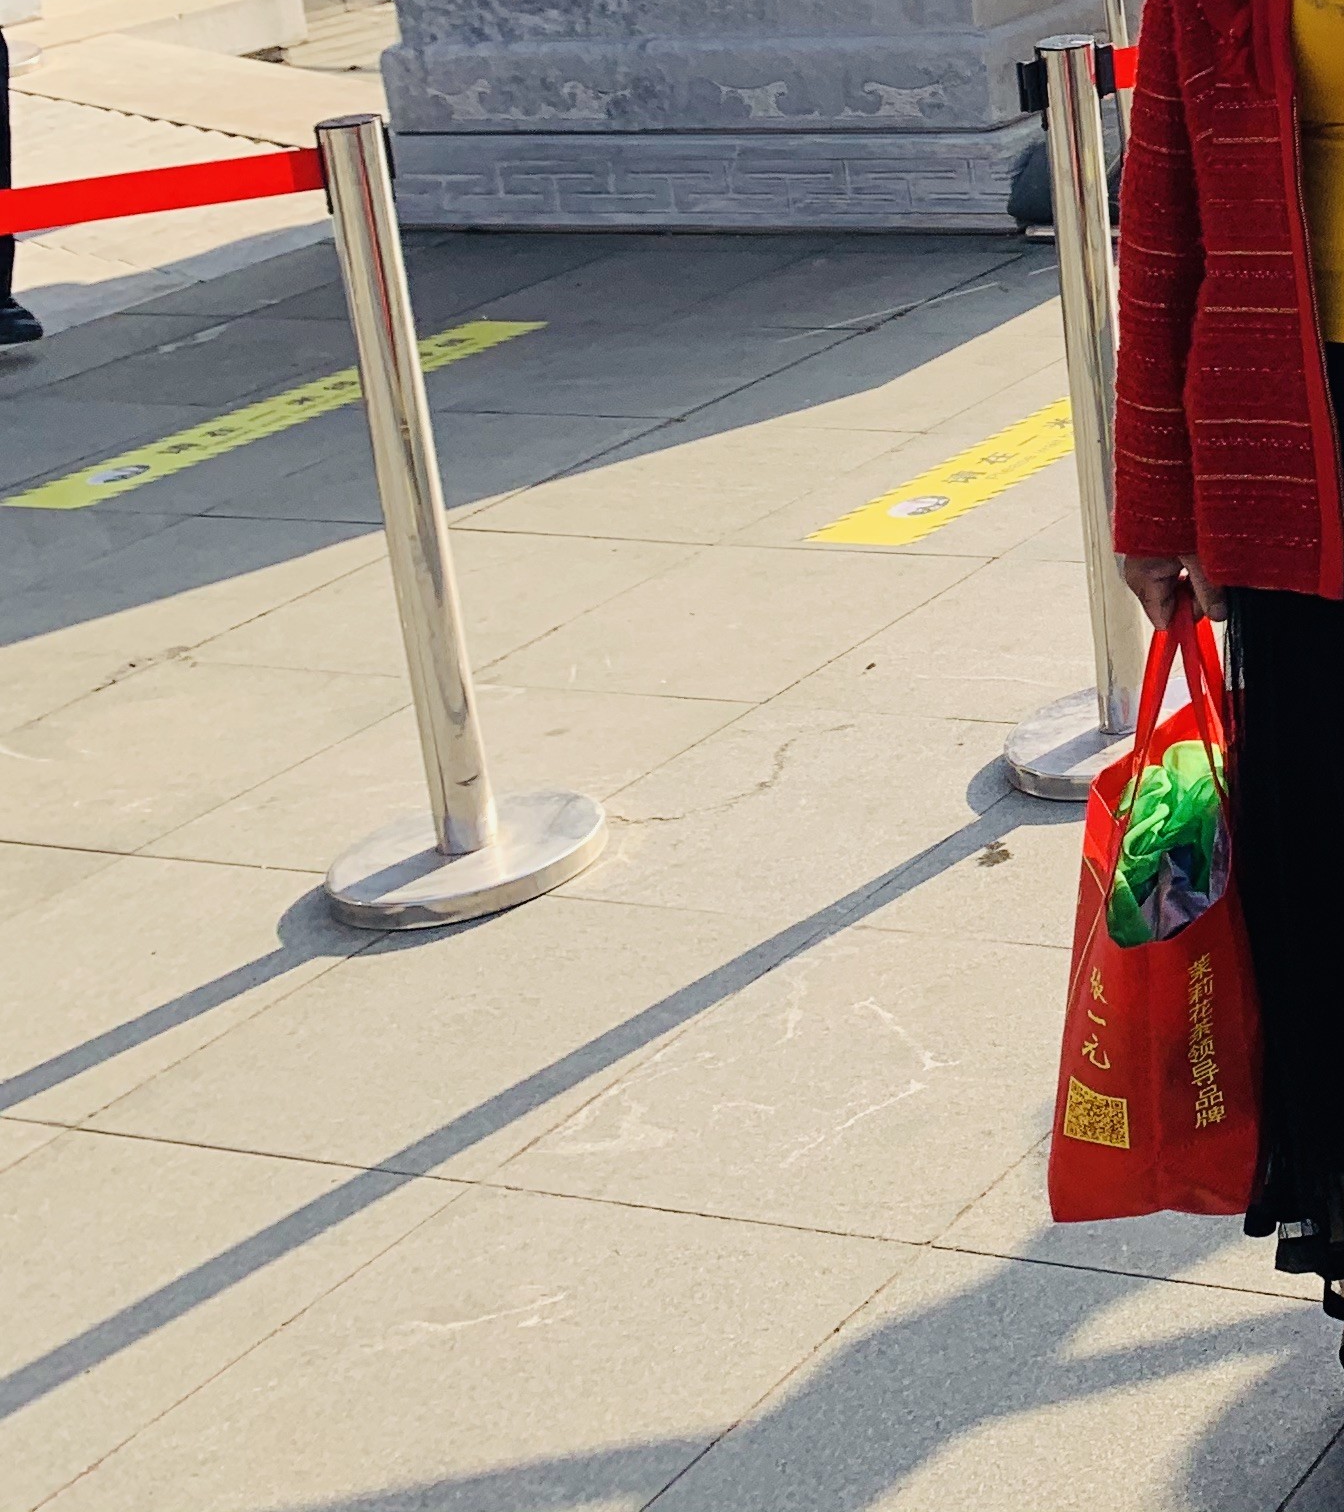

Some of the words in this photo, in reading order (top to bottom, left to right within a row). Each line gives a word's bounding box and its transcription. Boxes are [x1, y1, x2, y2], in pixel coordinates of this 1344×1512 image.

[1187, 952, 1227, 1129] 茉莉花茶领导品牌
